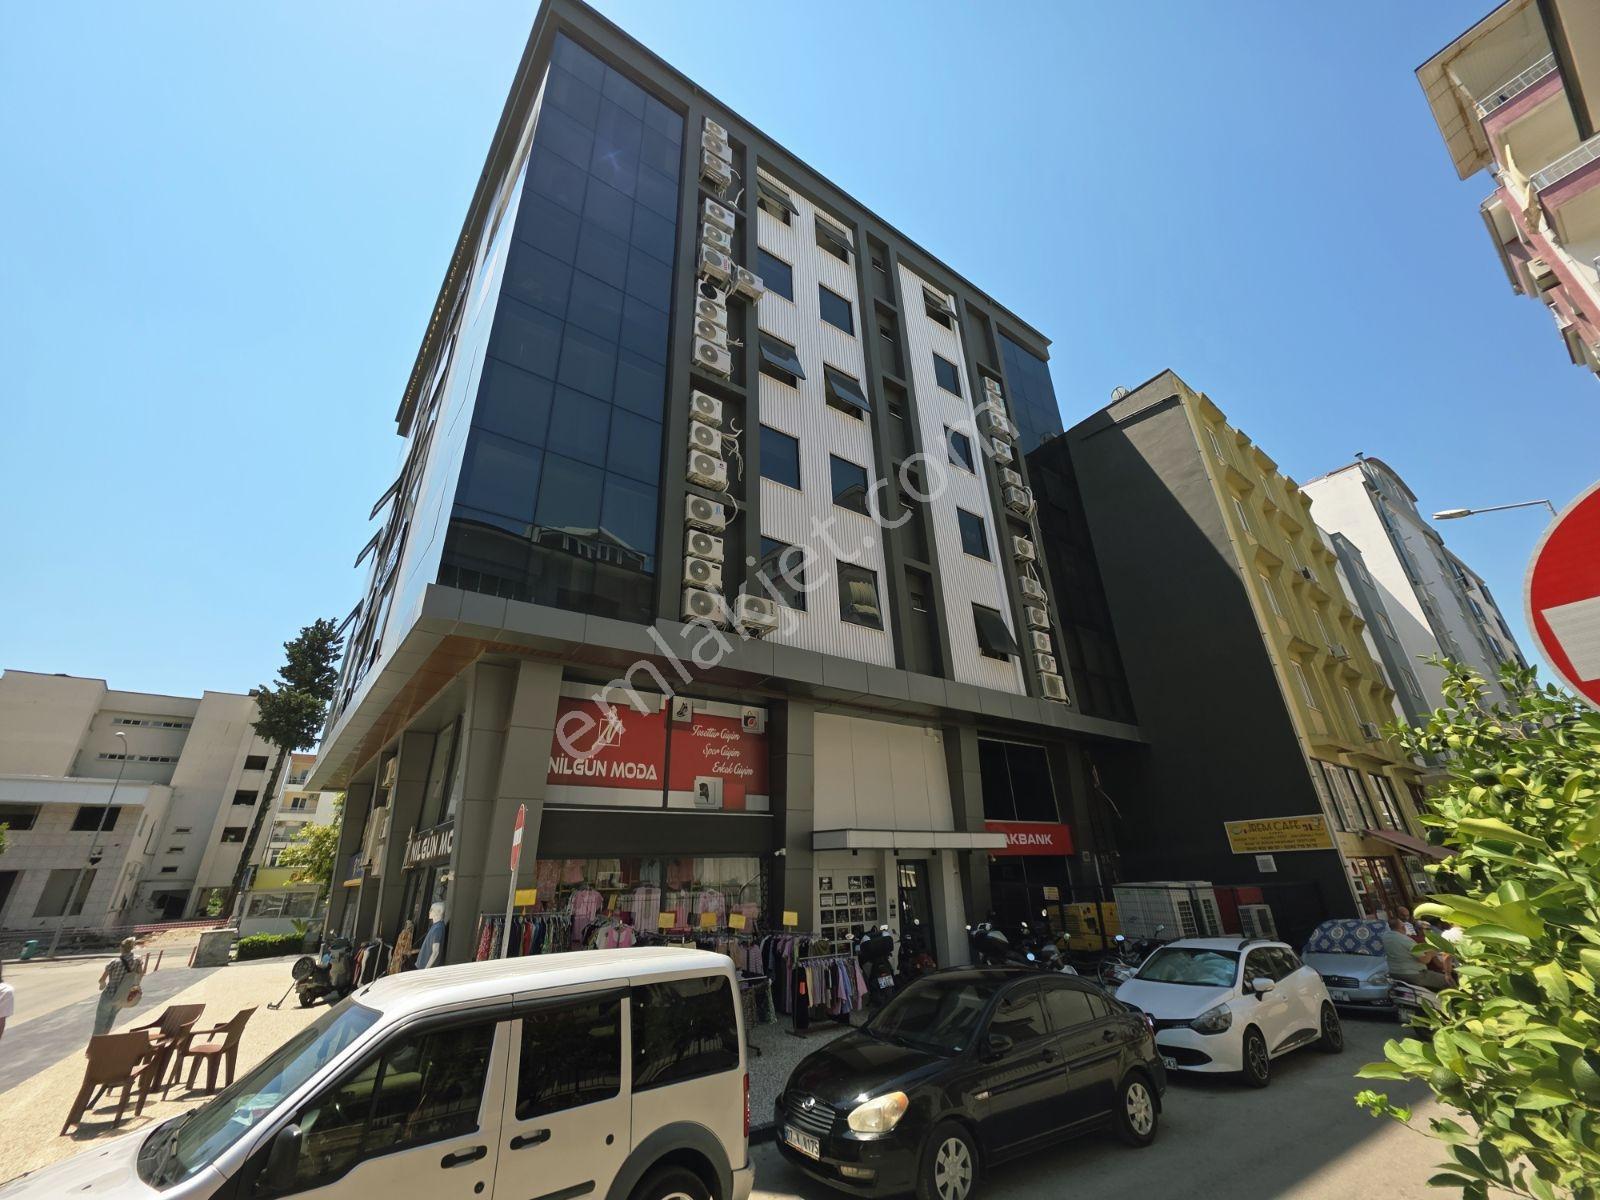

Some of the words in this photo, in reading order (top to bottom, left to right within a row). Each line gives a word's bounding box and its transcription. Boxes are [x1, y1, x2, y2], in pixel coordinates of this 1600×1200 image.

[720, 728, 740, 743] Giyim
[702, 743, 720, 758] Spor
[720, 745, 740, 760] Giyim
[547, 753, 607, 777] NİLGÜN
[610, 761, 658, 780] MODA
[712, 761, 734, 775] Erkek
[733, 763, 754, 779] Giyim
